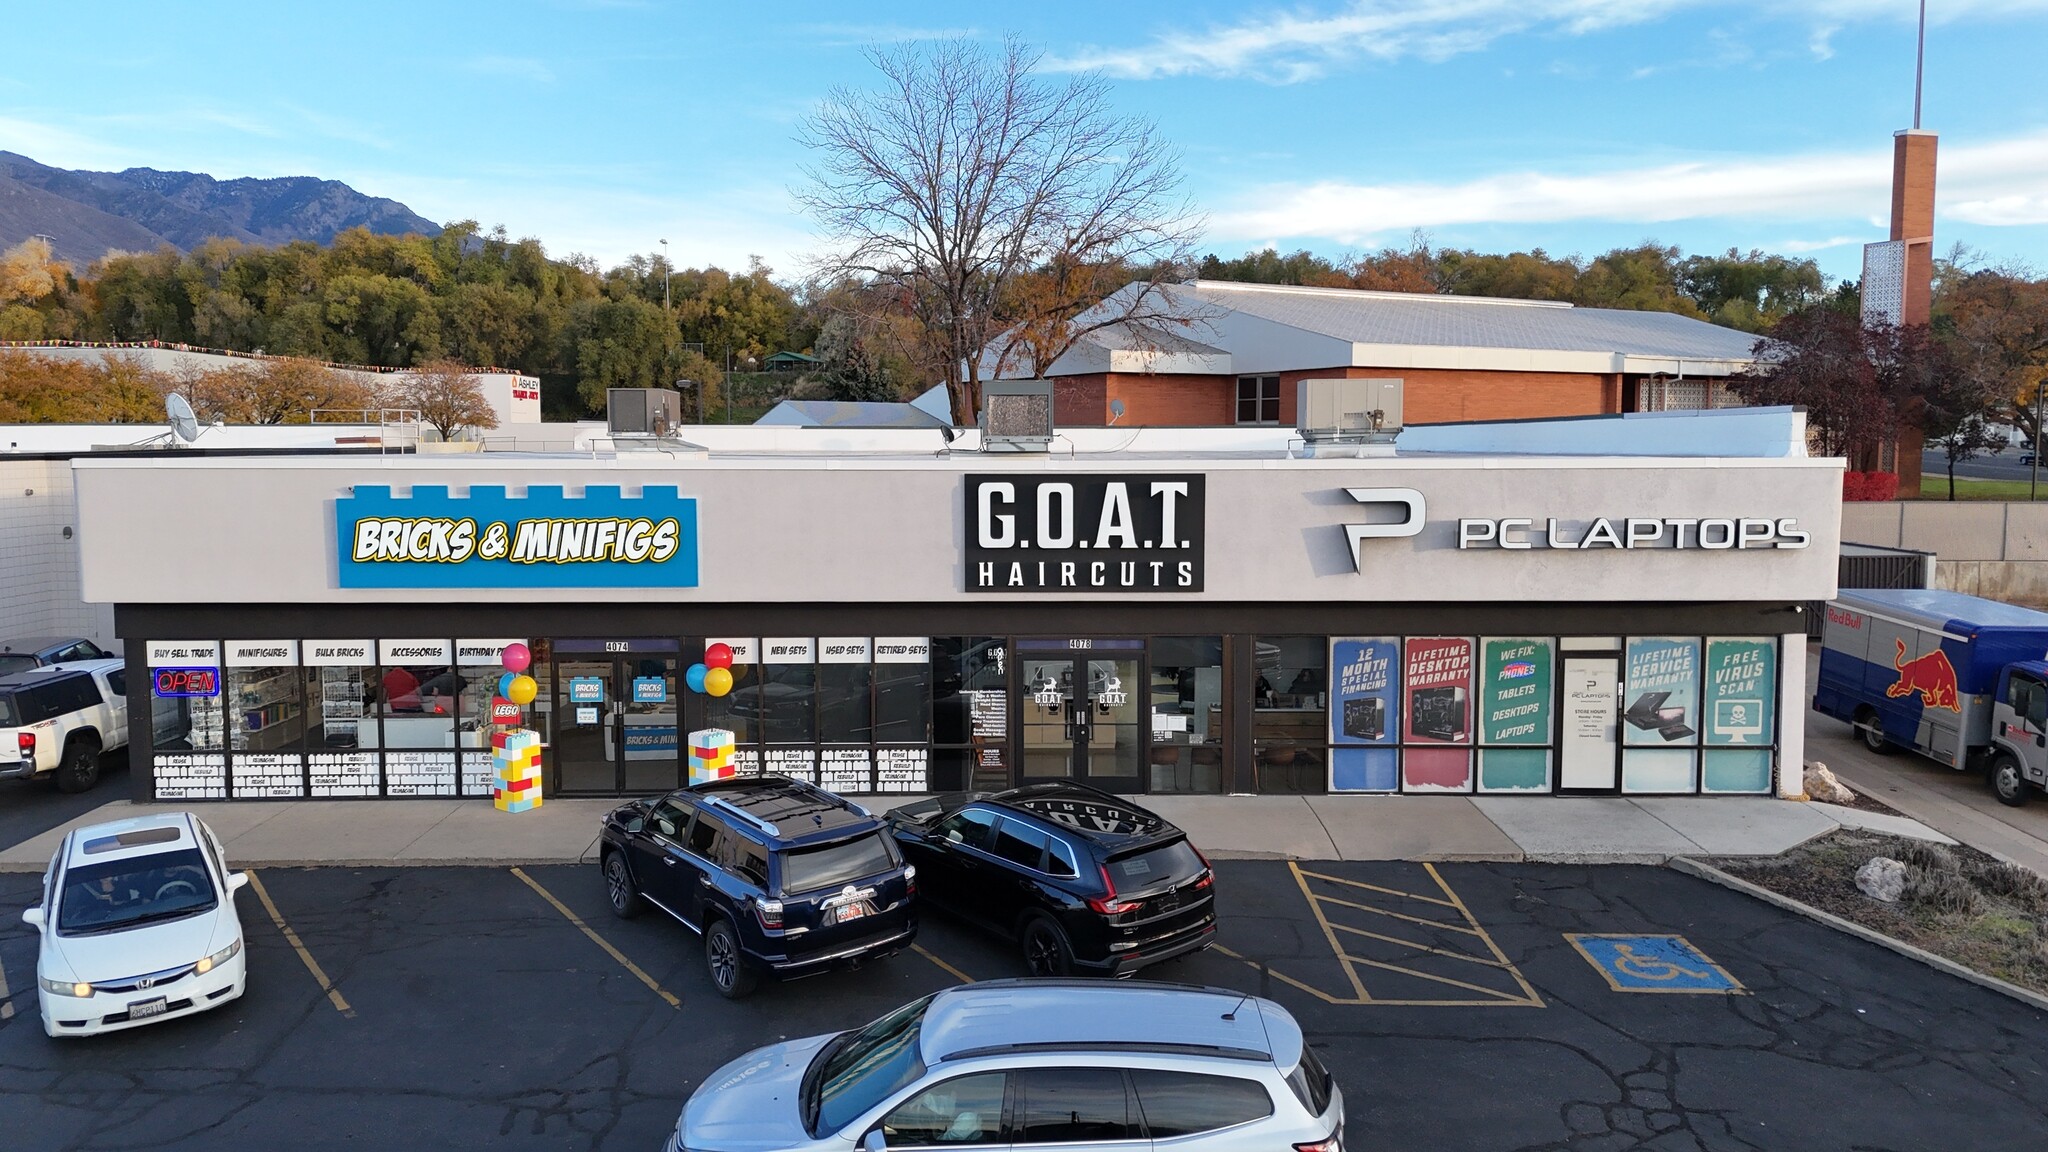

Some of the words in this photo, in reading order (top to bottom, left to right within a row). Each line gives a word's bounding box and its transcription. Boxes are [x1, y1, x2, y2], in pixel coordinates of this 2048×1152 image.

[519, 377, 538, 390] ASHLEY
[978, 482, 1190, 549] G.O.A.T.
[354, 517, 477, 563] BRICKS
[479, 522, 508, 561] &
[510, 517, 680, 564] MINIFIGS
[1457, 518, 1533, 548] PC
[1547, 518, 1812, 549] LAPTOPS
[978, 562, 1192, 586] HAIRCUTS
[459, 647, 496, 657] BIRTHDAY
[606, 642, 628, 651] 4074
[770, 646, 788, 656] NEW
[788, 646, 808, 655] SETS
[826, 646, 844, 655] USED
[846, 646, 865, 655] SETS
[876, 646, 907, 655] RETIRED
[908, 645, 928, 654] SETS
[1070, 640, 1091, 648] 4078
[154, 649, 170, 658] BUY
[170, 648, 188, 658] SELL
[190, 648, 214, 658] TRADE
[238, 648, 288, 658] MINIFIGURES
[315, 648, 334, 658] BULK
[336, 648, 364, 657] BRICKS
[391, 648, 442, 657] ACCESSORIES
[1358, 648, 1374, 662] 12
[1412, 644, 1468, 662] LIFETIME
[1501, 648, 1517, 660] WE
[1518, 646, 1535, 658] FIX:
[1633, 646, 1691, 664] LIFETIME
[1723, 650, 1759, 666] FREE
[1342, 658, 1388, 678] MONTH
[1409, 656, 1470, 675] DESKTOP
[1498, 664, 1536, 680] PHONES
[1632, 657, 1692, 678] SERVICE
[1716, 662, 1764, 684] VIRUS
[158, 672, 215, 692] OPEN
[1342, 670, 1386, 686] SPECIAL
[1410, 668, 1470, 686] WARRANTY
[1630, 670, 1693, 690] WARRANTY
[1341, 679, 1387, 696] FINANCING
[1498, 684, 1536, 700] TABLETS
[1718, 680, 1754, 696] SCAN
[494, 704, 520, 716] LEGO
[1492, 703, 1539, 721] DESKTOPS
[1496, 723, 1535, 740] LAPTOPS
[626, 736, 652, 744] BRICKS
